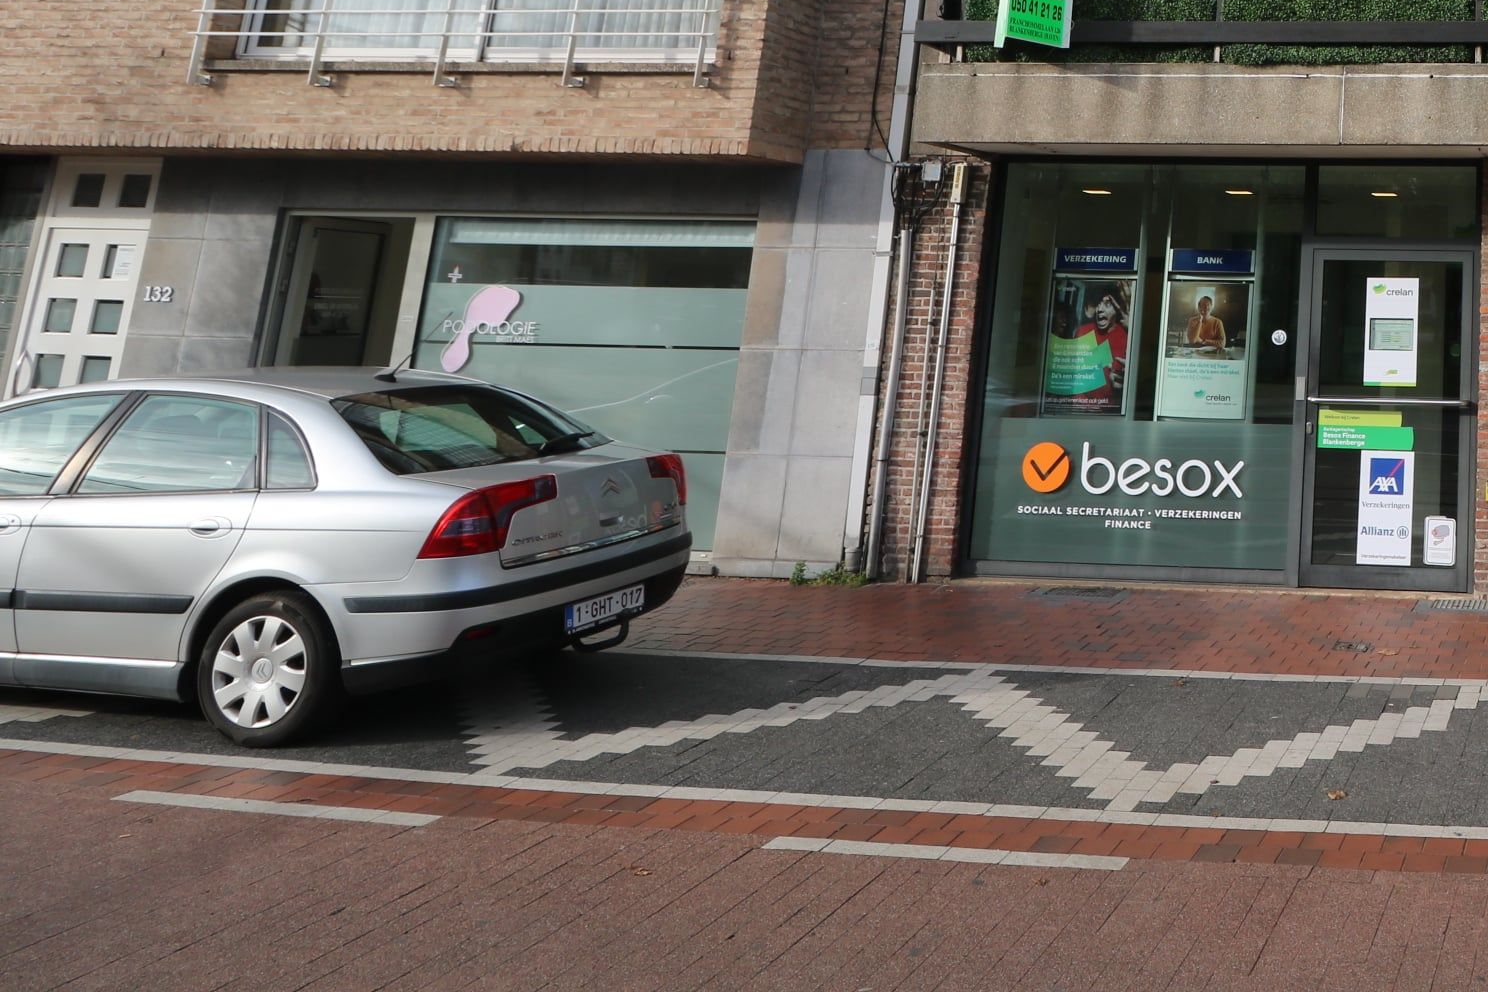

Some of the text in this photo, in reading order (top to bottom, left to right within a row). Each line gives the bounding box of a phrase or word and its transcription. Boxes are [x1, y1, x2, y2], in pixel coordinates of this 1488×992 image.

[1028, 0, 1039, 16] 41
[1040, 2, 1051, 19] 21
[1052, 5, 1063, 22] 26
[1063, 254, 1127, 264] VERZEKERING
[1196, 256, 1224, 265] BANK
[143, 285, 174, 303] 132
[1386, 288, 1414, 297] crelan
[1205, 394, 1231, 402] crelan
[1080, 441, 1245, 499] besox
[1369, 476, 1399, 492] AXA
[1361, 501, 1410, 510] Verzekeringen
[1017, 505, 1242, 520] SOCIAAL SECRETARIAAT VERZEKERINGEN
[1104, 520, 1152, 530] FINANCE
[1360, 526, 1395, 537] Allianz
